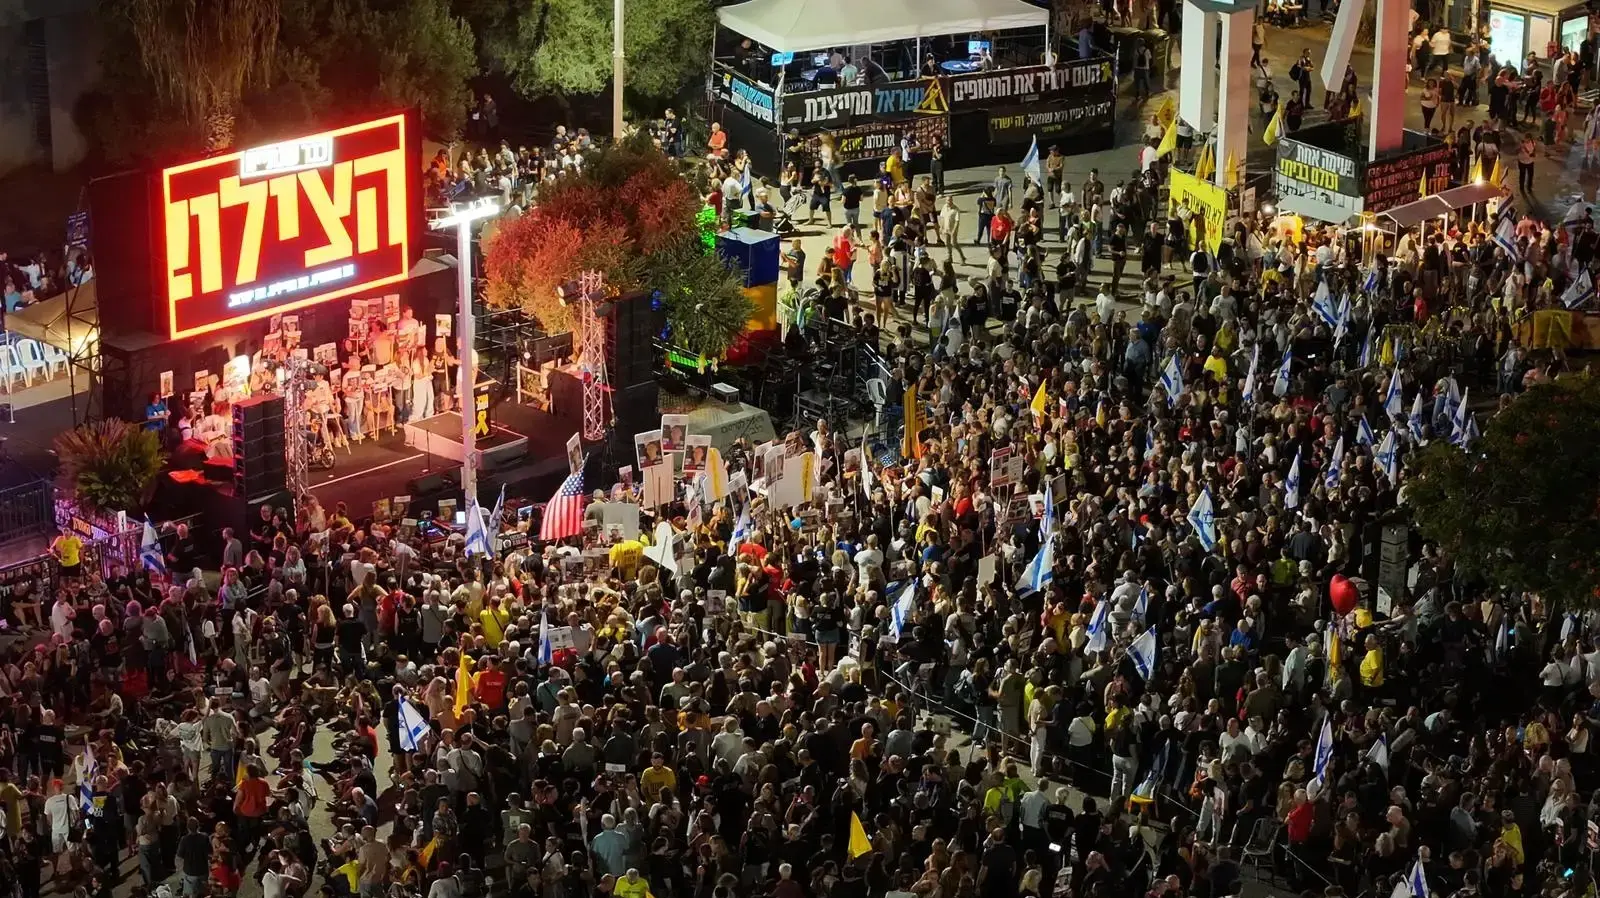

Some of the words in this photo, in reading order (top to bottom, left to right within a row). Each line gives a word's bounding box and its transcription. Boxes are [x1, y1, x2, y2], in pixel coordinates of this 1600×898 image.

[1014, 73, 1035, 95] את
[1072, 64, 1101, 87] העם
[875, 87, 925, 112] ישראל
[954, 76, 1012, 101] החטופים
[1014, 115, 1024, 127] זה
[884, 133, 896, 147] את
[1295, 144, 1320, 168] אחת
[1311, 166, 1340, 191] וכולם
[167, 148, 406, 300] הצילו!
